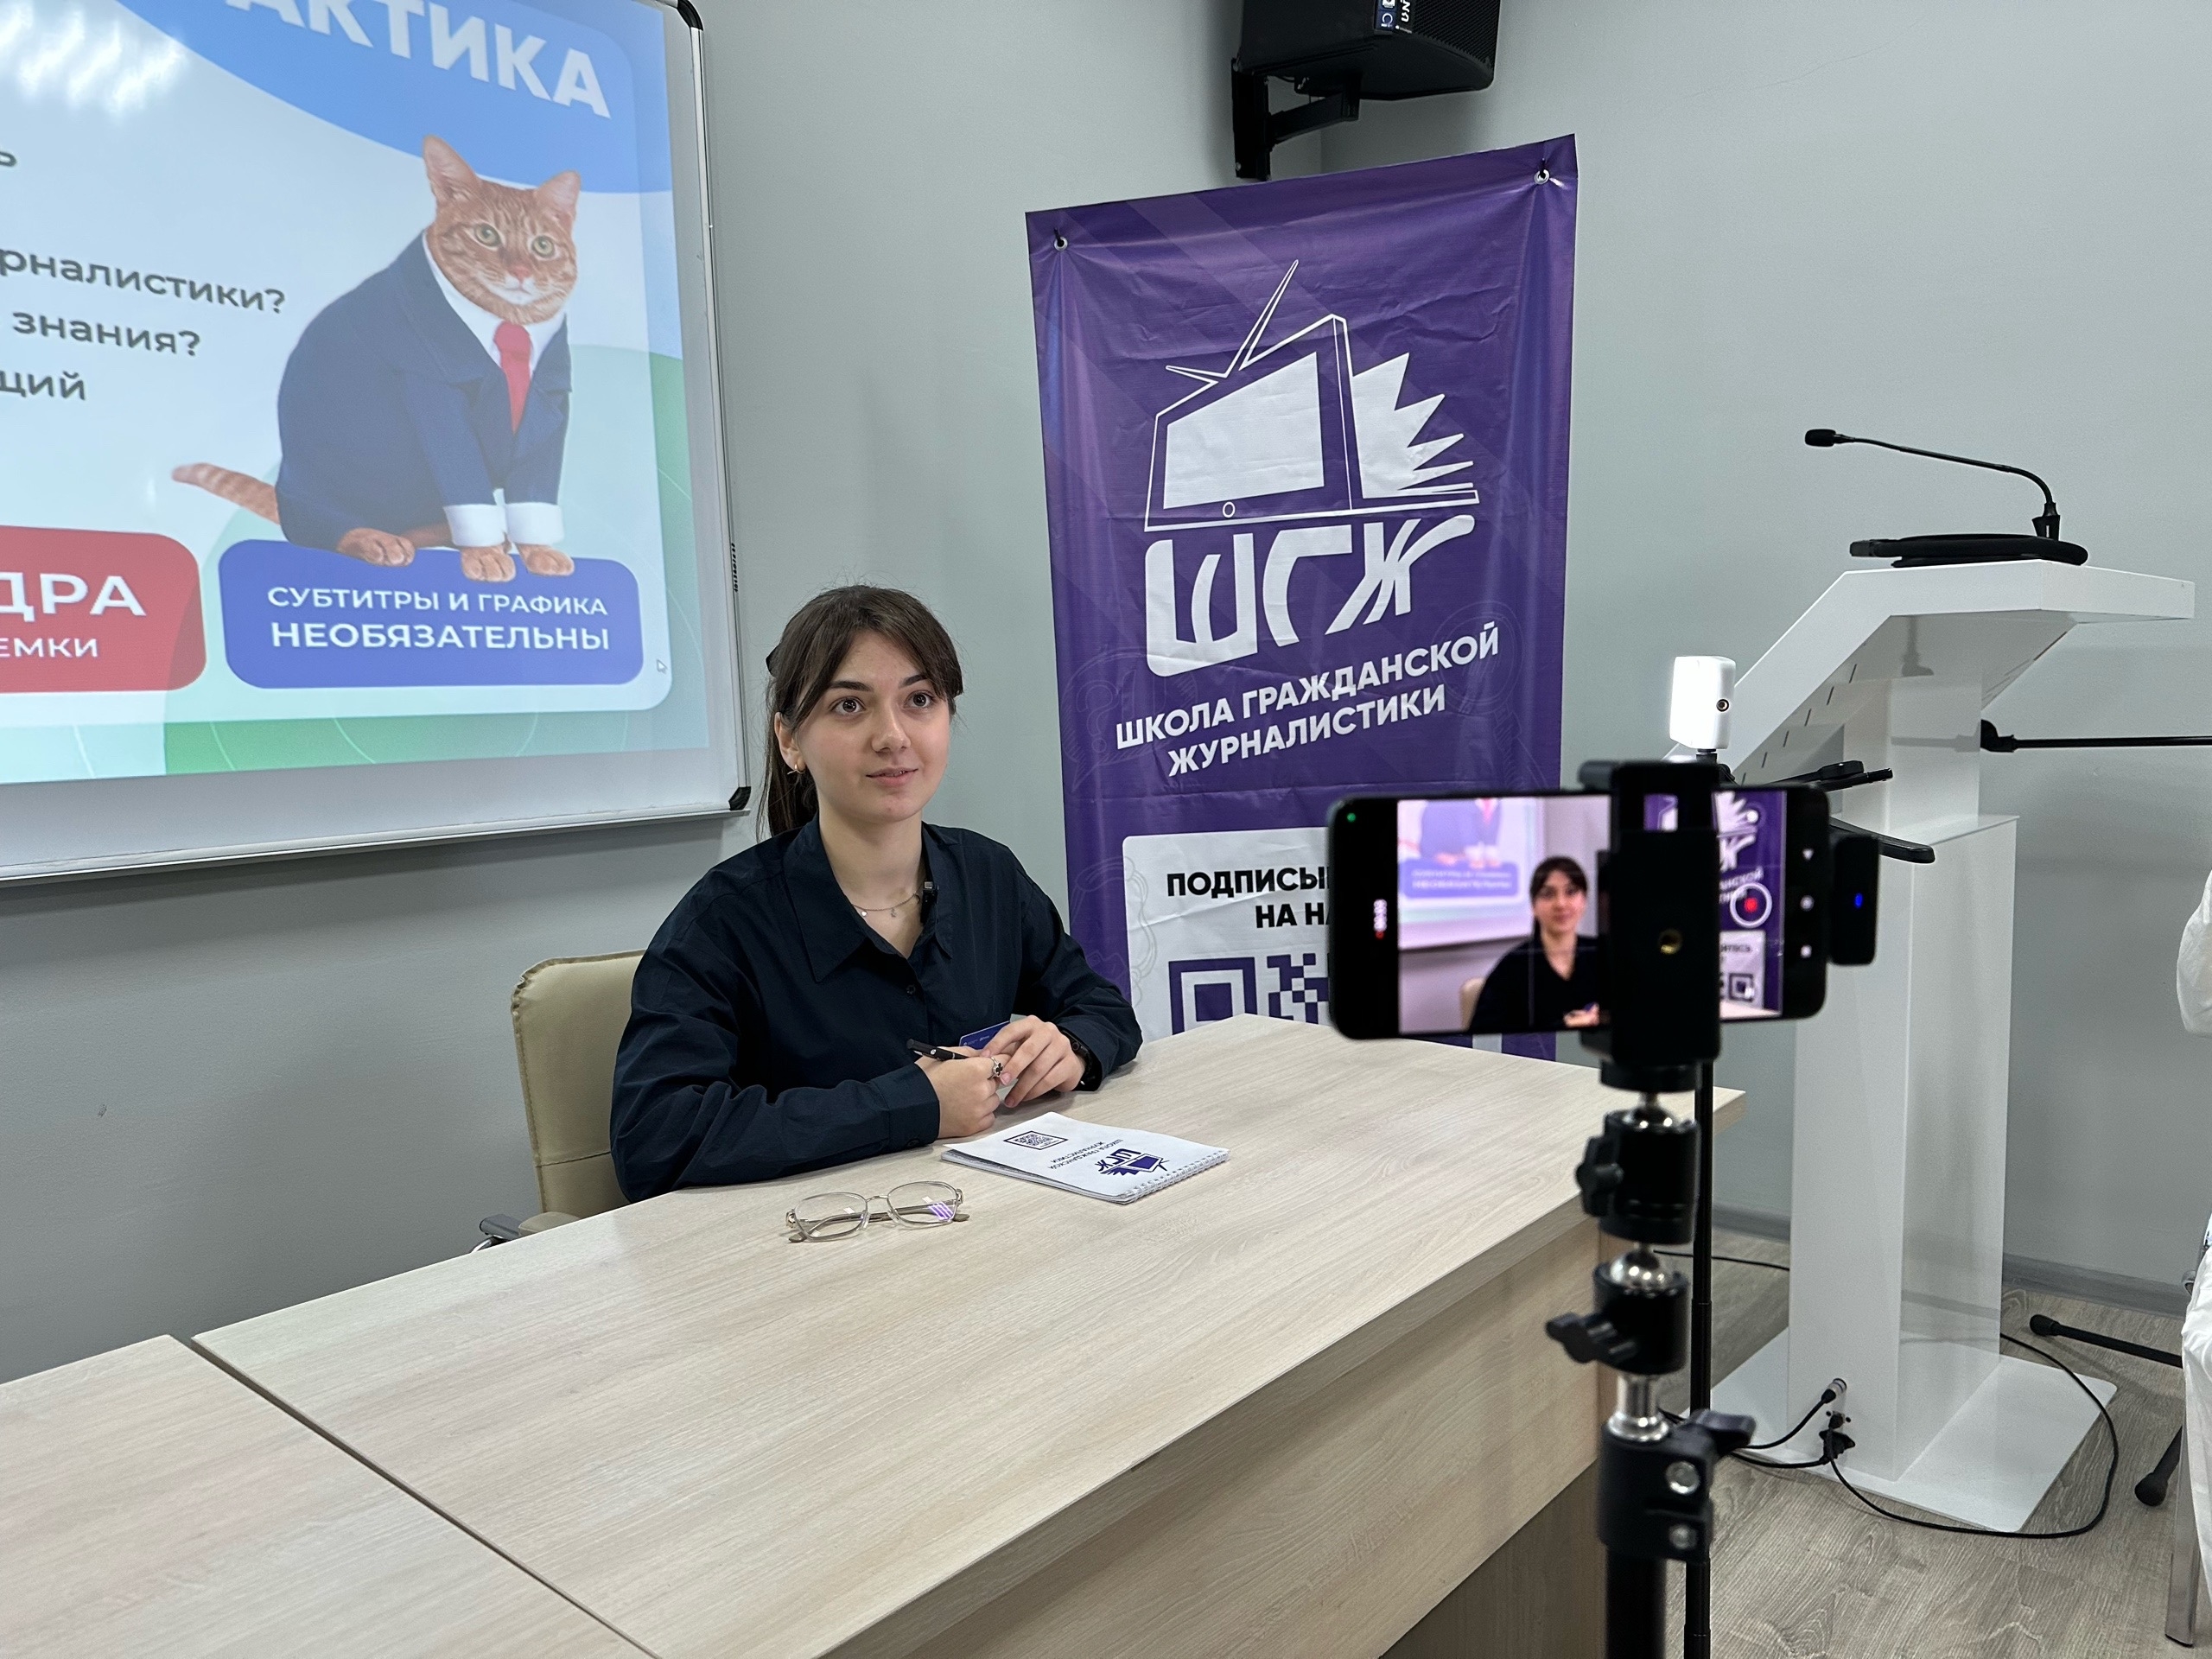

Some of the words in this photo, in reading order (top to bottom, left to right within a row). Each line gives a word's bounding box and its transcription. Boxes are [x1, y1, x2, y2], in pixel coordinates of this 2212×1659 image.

[0, 249, 286, 314] рналистики?
[12, 312, 200, 356] знания?
[0, 572, 146, 622] ДРА
[267, 587, 439, 611] СУБТИТРЫ
[448, 593, 469, 611] И
[478, 594, 608, 616] ГРАФИКА
[1145, 514, 1475, 677] ШГЖ
[270, 622, 609, 650] НЕОБЯЗАТЕЛЬНЫ
[1116, 697, 1235, 750] ШКОЛА
[1242, 621, 1499, 719] ГРАЖДАНСКОЙ
[1167, 683, 1446, 777] ЖУРНАЛИСТИКИ
[1167, 867, 1331, 899] ПОДПИСЫ
[1255, 903, 1298, 928] НА
[1305, 902, 1331, 925] Н
